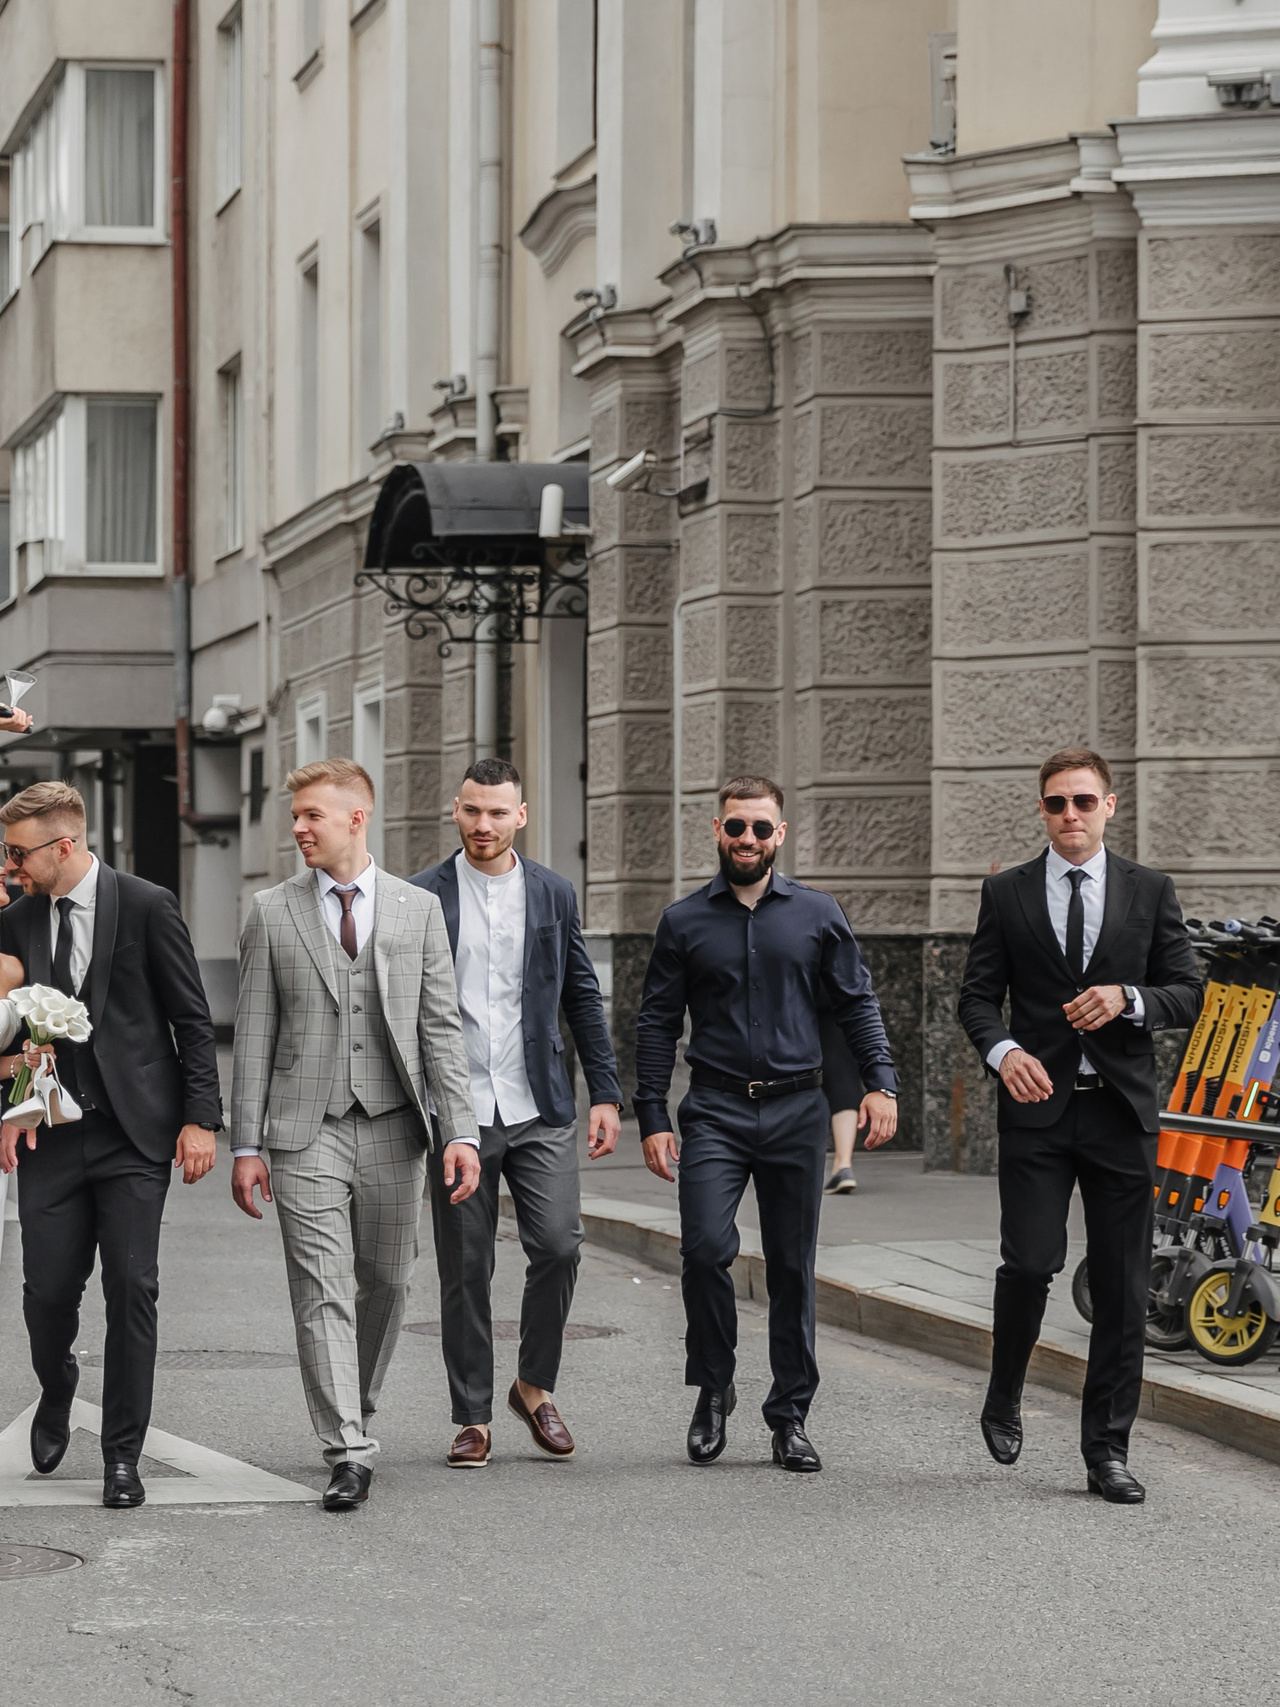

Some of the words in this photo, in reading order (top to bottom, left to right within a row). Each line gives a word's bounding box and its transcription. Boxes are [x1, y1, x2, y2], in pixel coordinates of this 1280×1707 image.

[1186, 1014, 1208, 1065] WHOOSH
[1206, 1018, 1229, 1070] WHOOSH
[1230, 1021, 1253, 1074] WHOOSH
